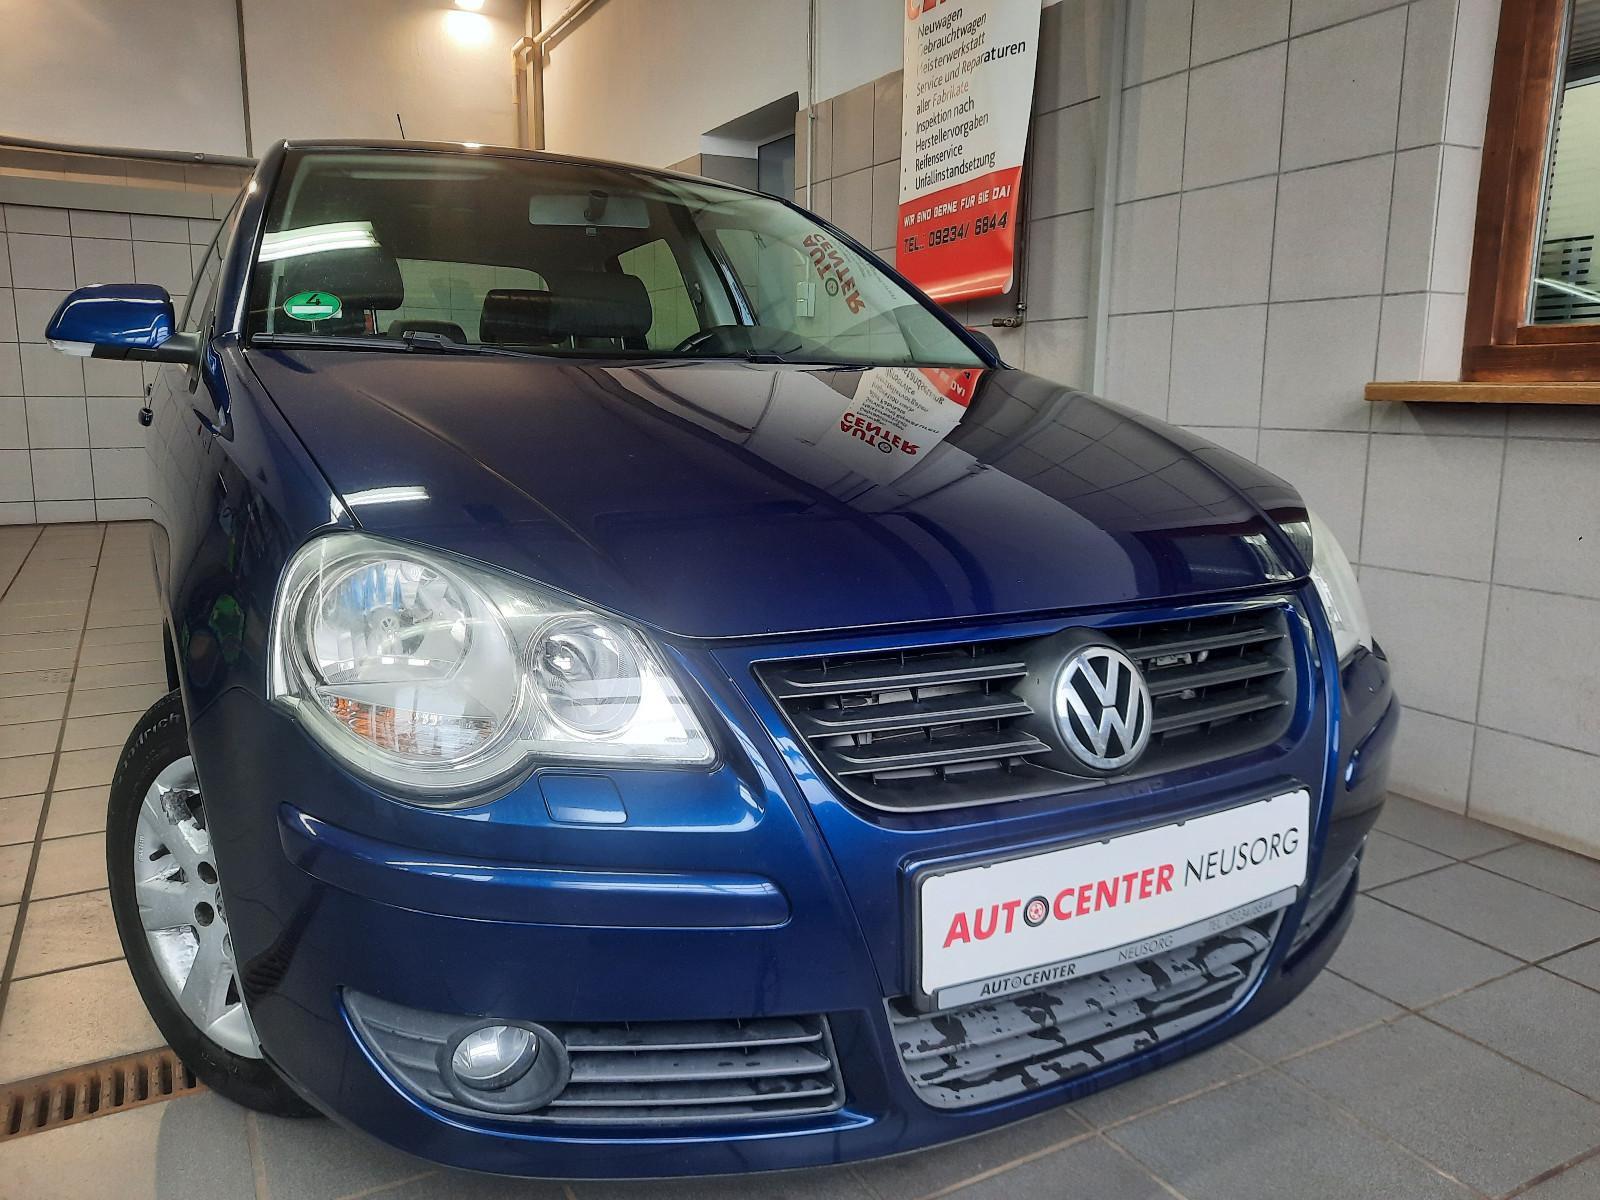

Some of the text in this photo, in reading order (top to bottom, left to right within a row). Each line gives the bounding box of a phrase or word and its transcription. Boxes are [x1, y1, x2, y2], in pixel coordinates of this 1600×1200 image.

[917, 8, 963, 40] Neuwagen
[916, 41, 1026, 97] Service und Reparaturen
[915, 95, 975, 135] Inspektion nach
[916, 81, 969, 115] aller Fabrikate
[915, 112, 989, 153] Herstellervorgaben
[915, 144, 963, 172] Reifenservice
[915, 152, 996, 190] Unfallinstandsetzung
[903, 214, 915, 227] WIR
[978, 190, 989, 204] SIE
[974, 211, 1008, 236] 6844
[306, 293, 321, 306] 4
[1183, 827, 1300, 887] NEUSORG
[1117, 934, 1174, 962] NEUSORG
